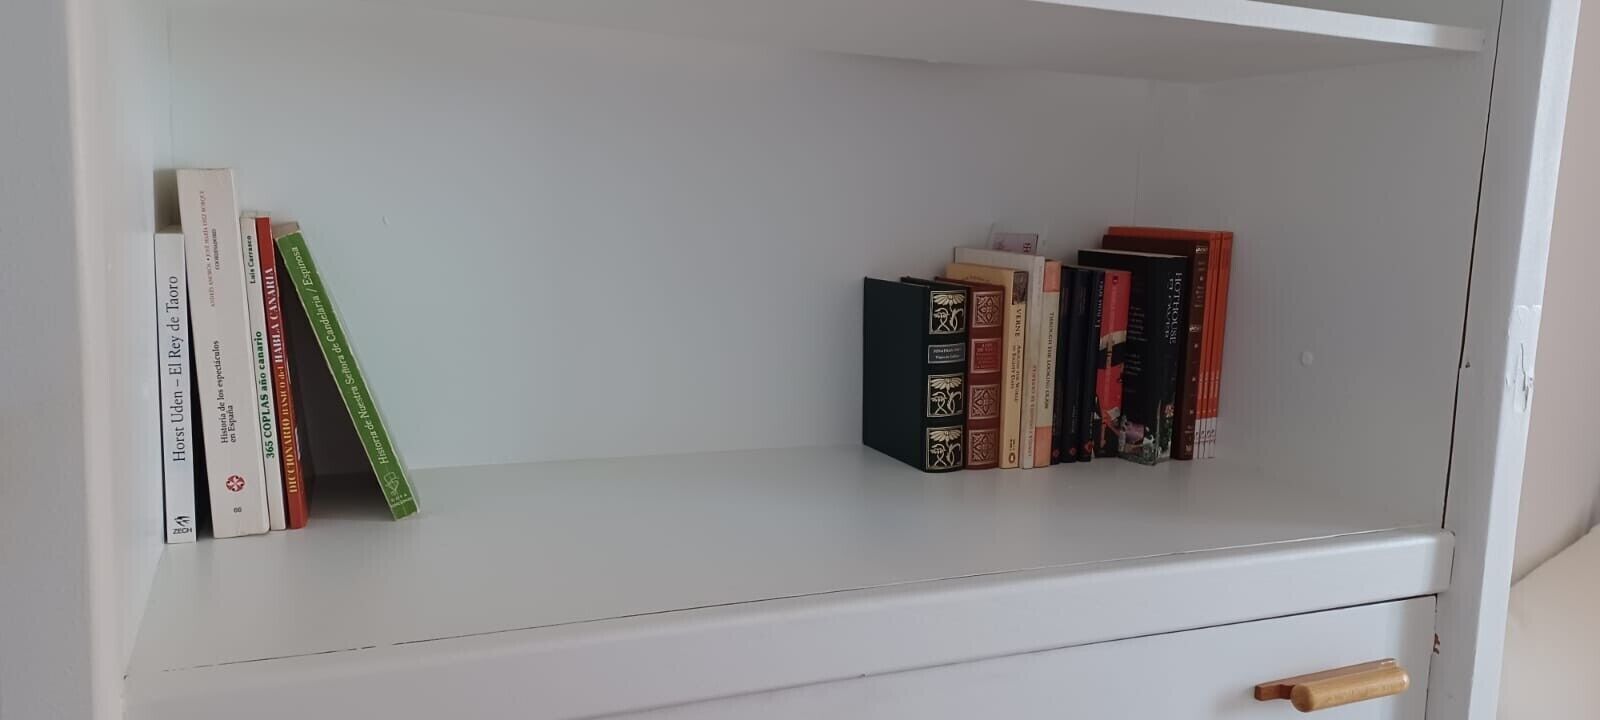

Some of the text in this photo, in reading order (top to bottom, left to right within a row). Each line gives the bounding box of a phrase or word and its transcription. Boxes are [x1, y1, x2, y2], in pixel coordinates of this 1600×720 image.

[246, 236, 255, 267] Carrasco
[292, 246, 313, 285] Espinosa
[165, 276, 179, 312] Taoro
[264, 268, 278, 320] CANARIA
[1169, 272, 1183, 344] HOTHOUSE
[166, 317, 180, 331] de
[313, 296, 336, 342] Candelaria
[168, 336, 183, 358] Rey
[271, 323, 283, 363] HABLA
[332, 344, 341, 353] de
[168, 363, 182, 375] El
[277, 366, 286, 379] del
[338, 355, 354, 384] Señora
[170, 391, 184, 423] Uden
[212, 340, 228, 443] Historia de los espectáculos
[254, 331, 275, 459] 365 COPLAS año canario
[352, 386, 369, 418] Nuestra
[226, 405, 237, 442] en España
[364, 420, 374, 430] de
[173, 428, 186, 461] Horst
[281, 418, 298, 493] DICCIONARIO
[370, 431, 389, 464] Historia
